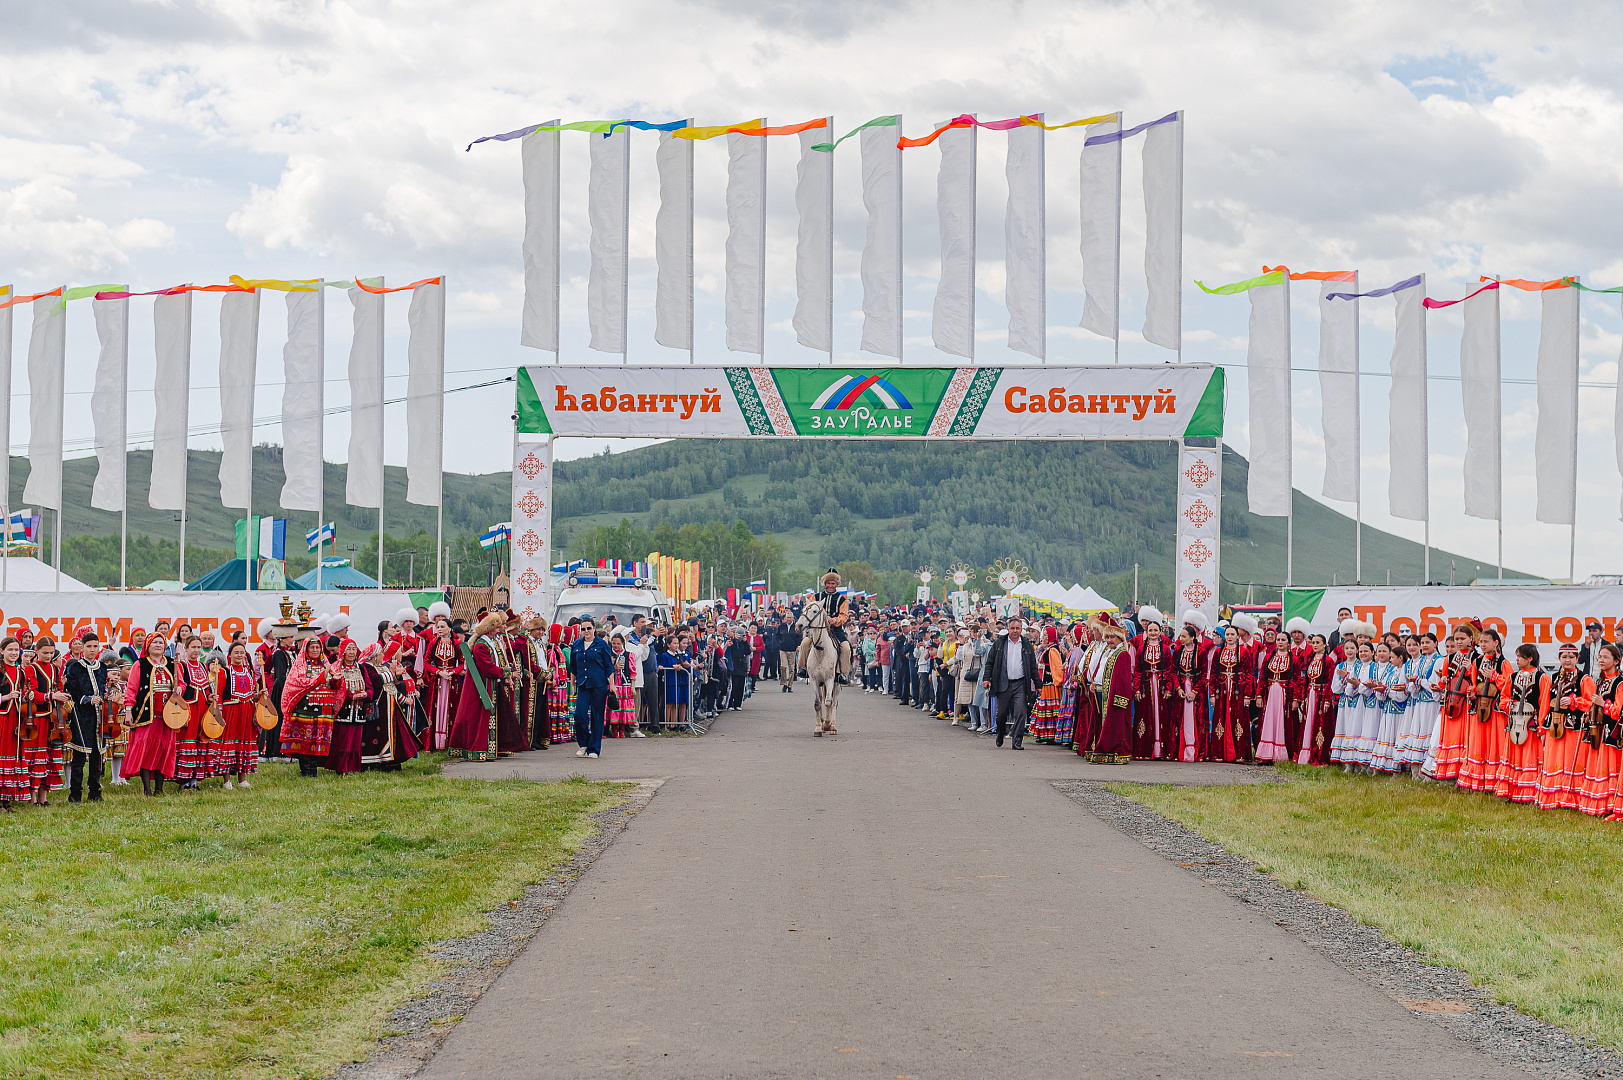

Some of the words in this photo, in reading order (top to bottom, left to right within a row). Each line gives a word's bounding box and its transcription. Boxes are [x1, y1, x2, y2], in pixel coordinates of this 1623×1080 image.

[811, 406, 912, 429] ЗАУРАЛЬЕ
[1004, 386, 1176, 421] Сабантуй
[0, 608, 133, 643] ахим
